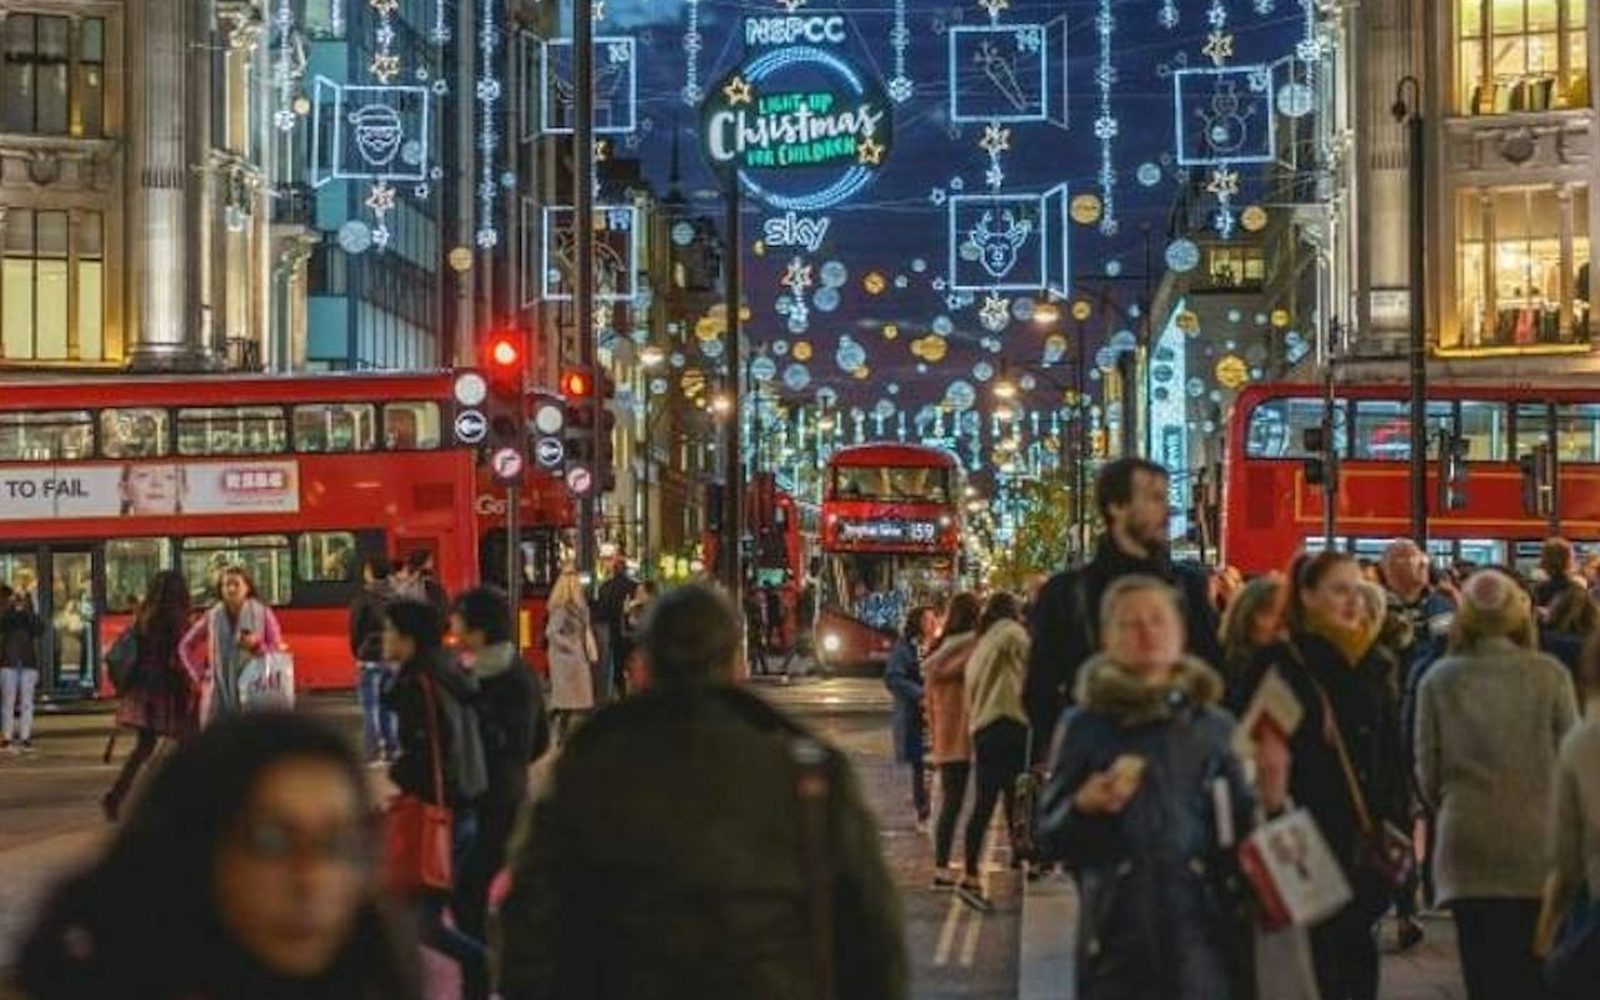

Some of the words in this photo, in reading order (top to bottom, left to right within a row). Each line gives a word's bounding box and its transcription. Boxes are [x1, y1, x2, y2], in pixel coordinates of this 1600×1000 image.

[745, 17, 846, 44] NSPCC
[809, 93, 834, 114] UP
[708, 104, 883, 160] Christmas
[778, 136, 855, 166] CHILDREN
[763, 212, 829, 251] sky
[6, 480, 36, 498] TO
[43, 479, 88, 498] FAIL
